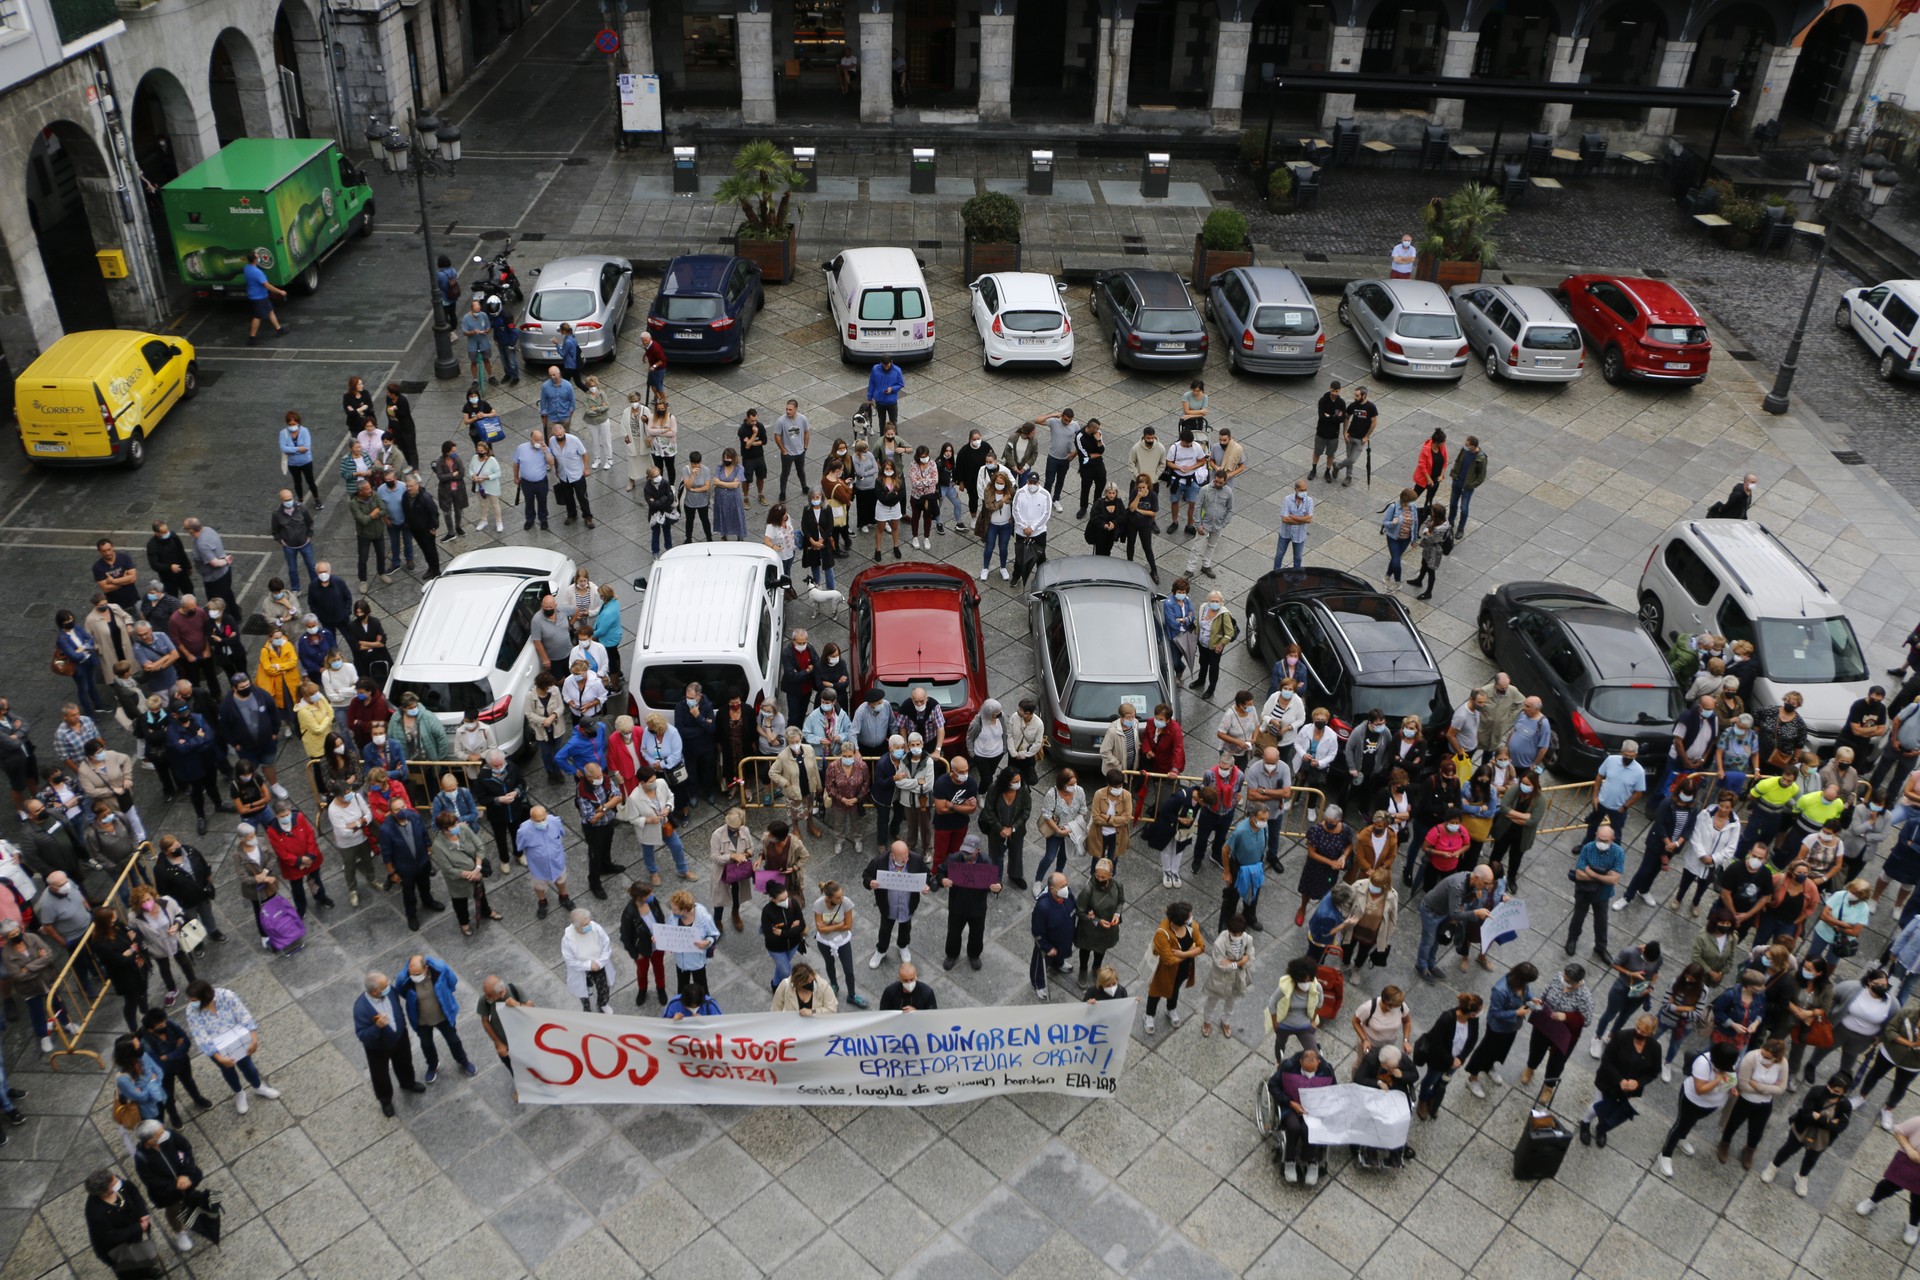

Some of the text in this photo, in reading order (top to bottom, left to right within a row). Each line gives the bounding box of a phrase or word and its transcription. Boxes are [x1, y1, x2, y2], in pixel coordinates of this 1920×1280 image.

[229, 206, 264, 215] Heineken
[41, 404, 85, 415] CORREOS
[667, 1033, 798, 1063] SAN JOSE
[824, 1023, 1110, 1057] ZAINTZA DUINAREN ALDE
[527, 1022, 659, 1087] SOS
[859, 1051, 1022, 1079] ERREFORTZUAK
[911, 1083, 930, 1095] eta
